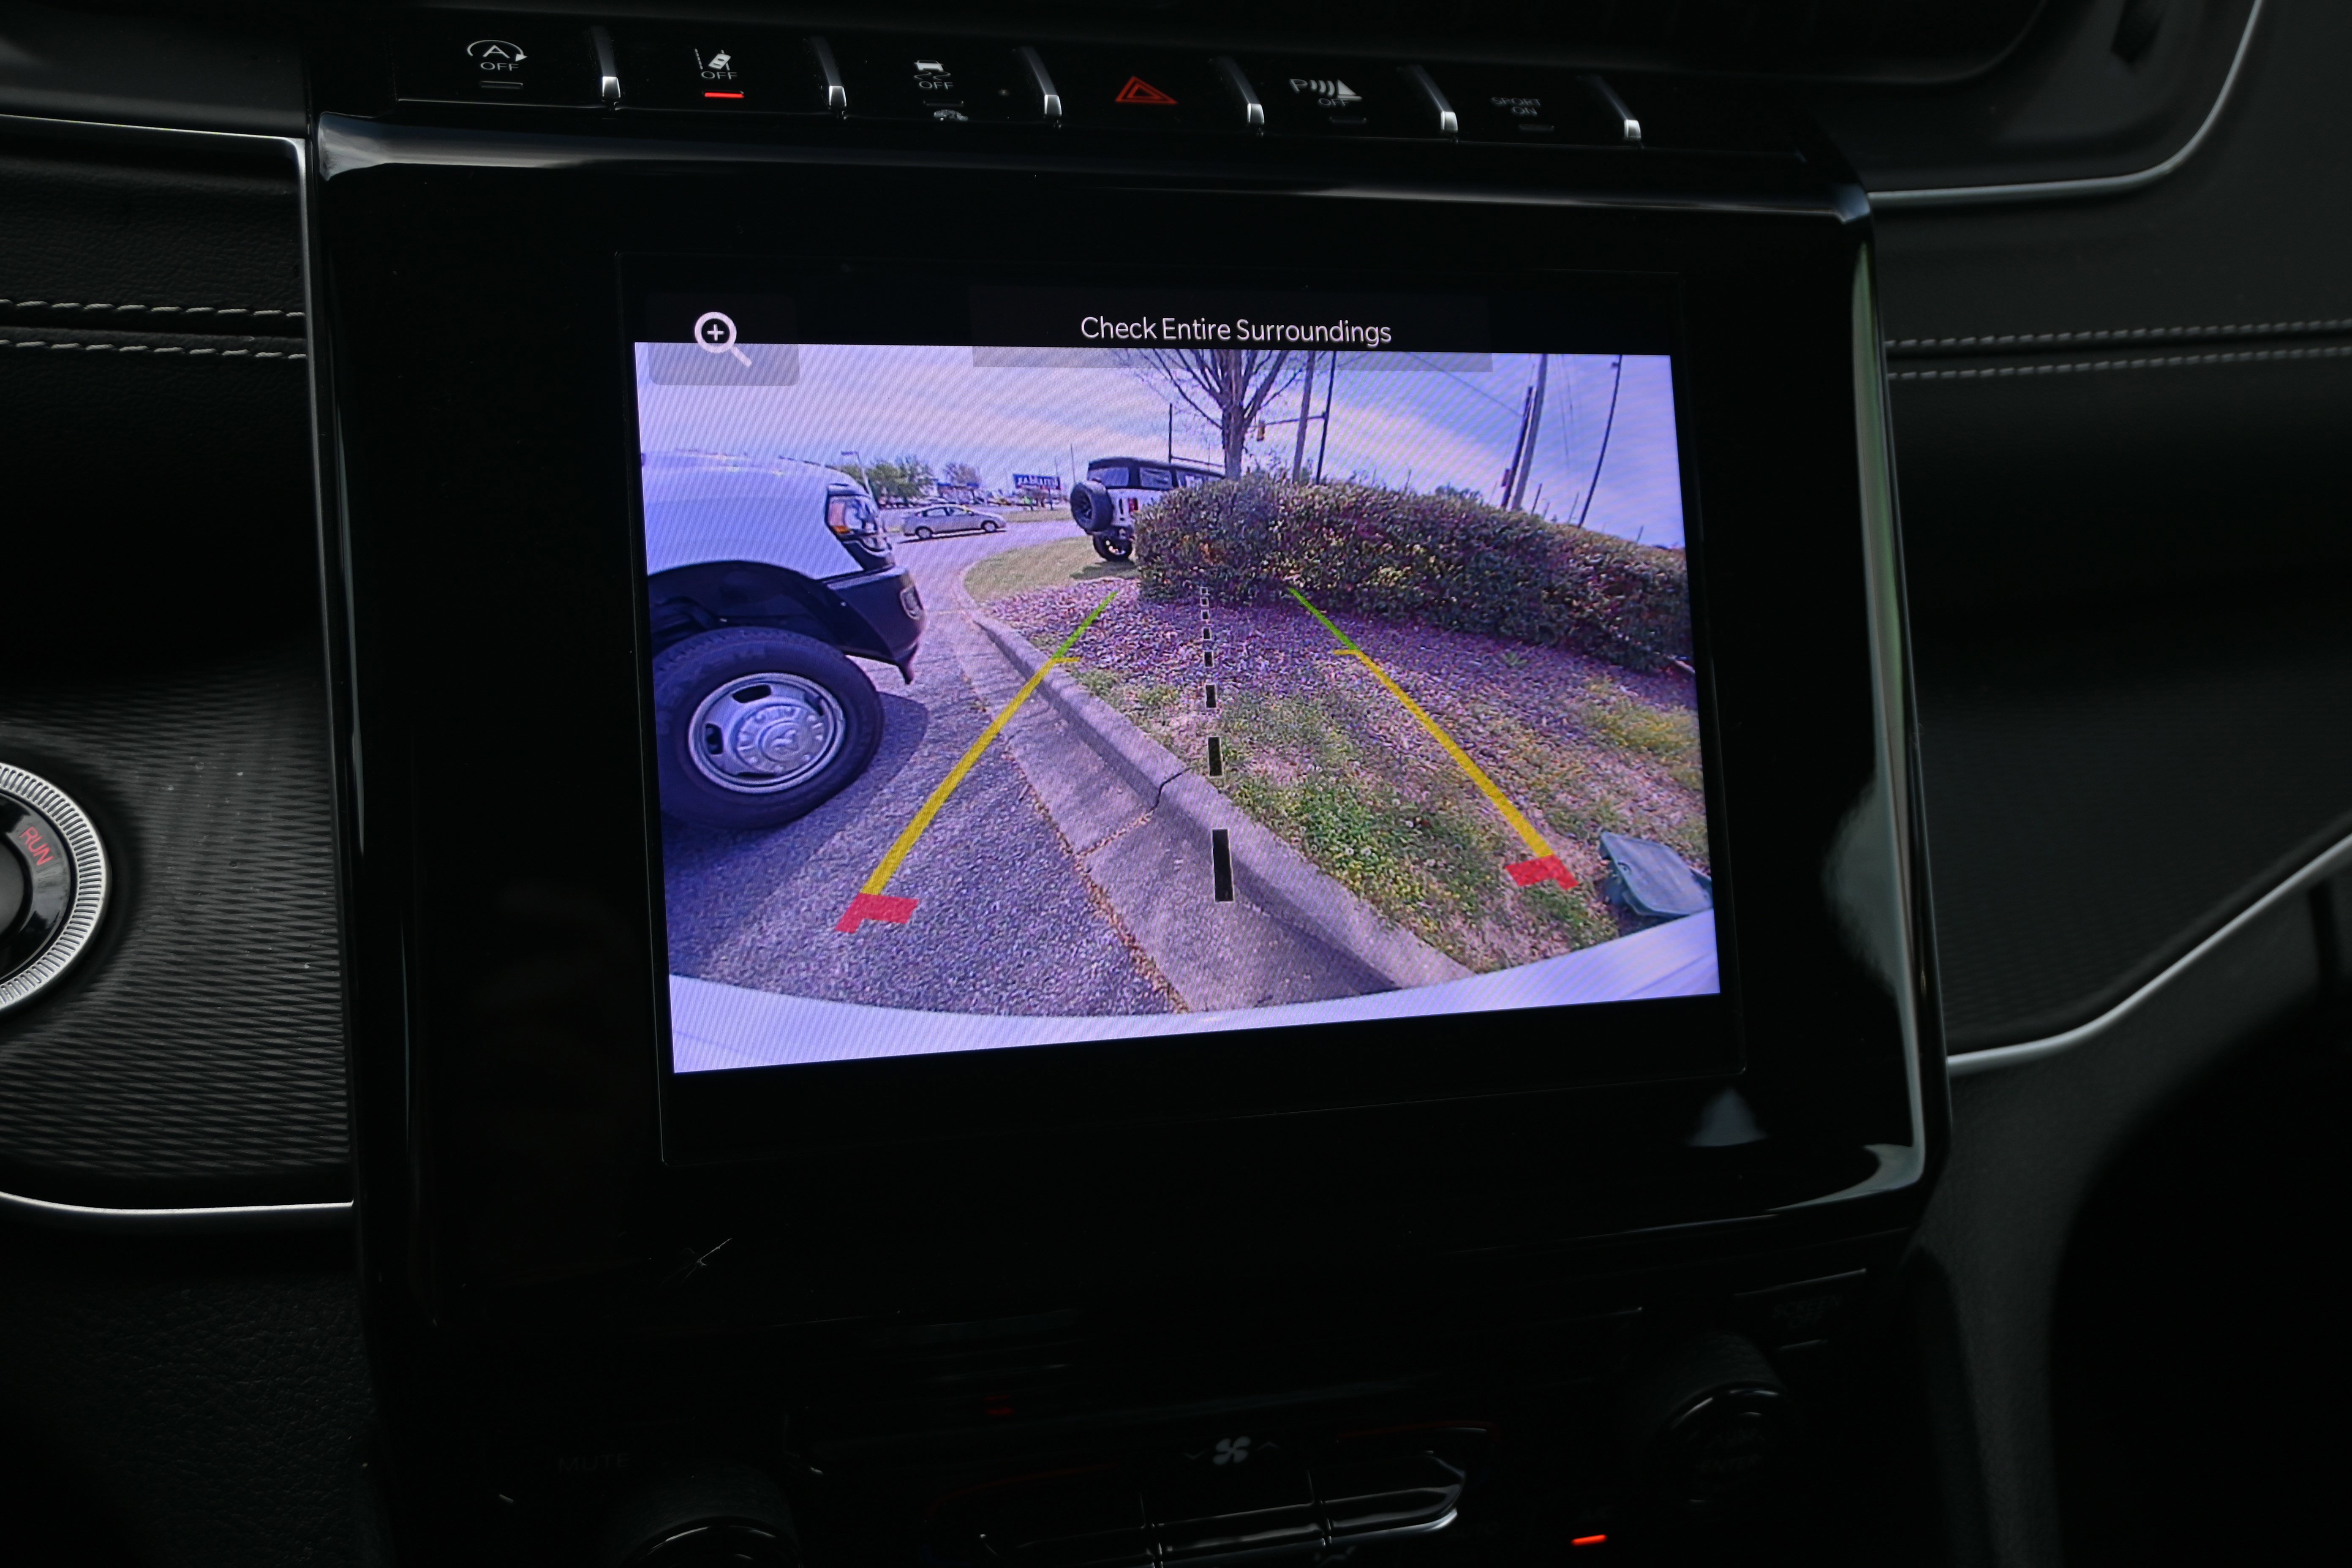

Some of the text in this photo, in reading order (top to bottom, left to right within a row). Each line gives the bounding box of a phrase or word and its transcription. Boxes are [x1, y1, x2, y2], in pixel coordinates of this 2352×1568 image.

[480, 62, 519, 71] OFF
[701, 71, 738, 80] OFF
[918, 81, 954, 90] OFF
[1318, 98, 1349, 108] OFF
[1489, 97, 1541, 107] SPORT
[1511, 106, 1538, 117] ON
[1081, 316, 1392, 348] Check Entire Surroundings
[19, 825, 55, 866] RUN
[558, 1452, 630, 1474] MUTE
